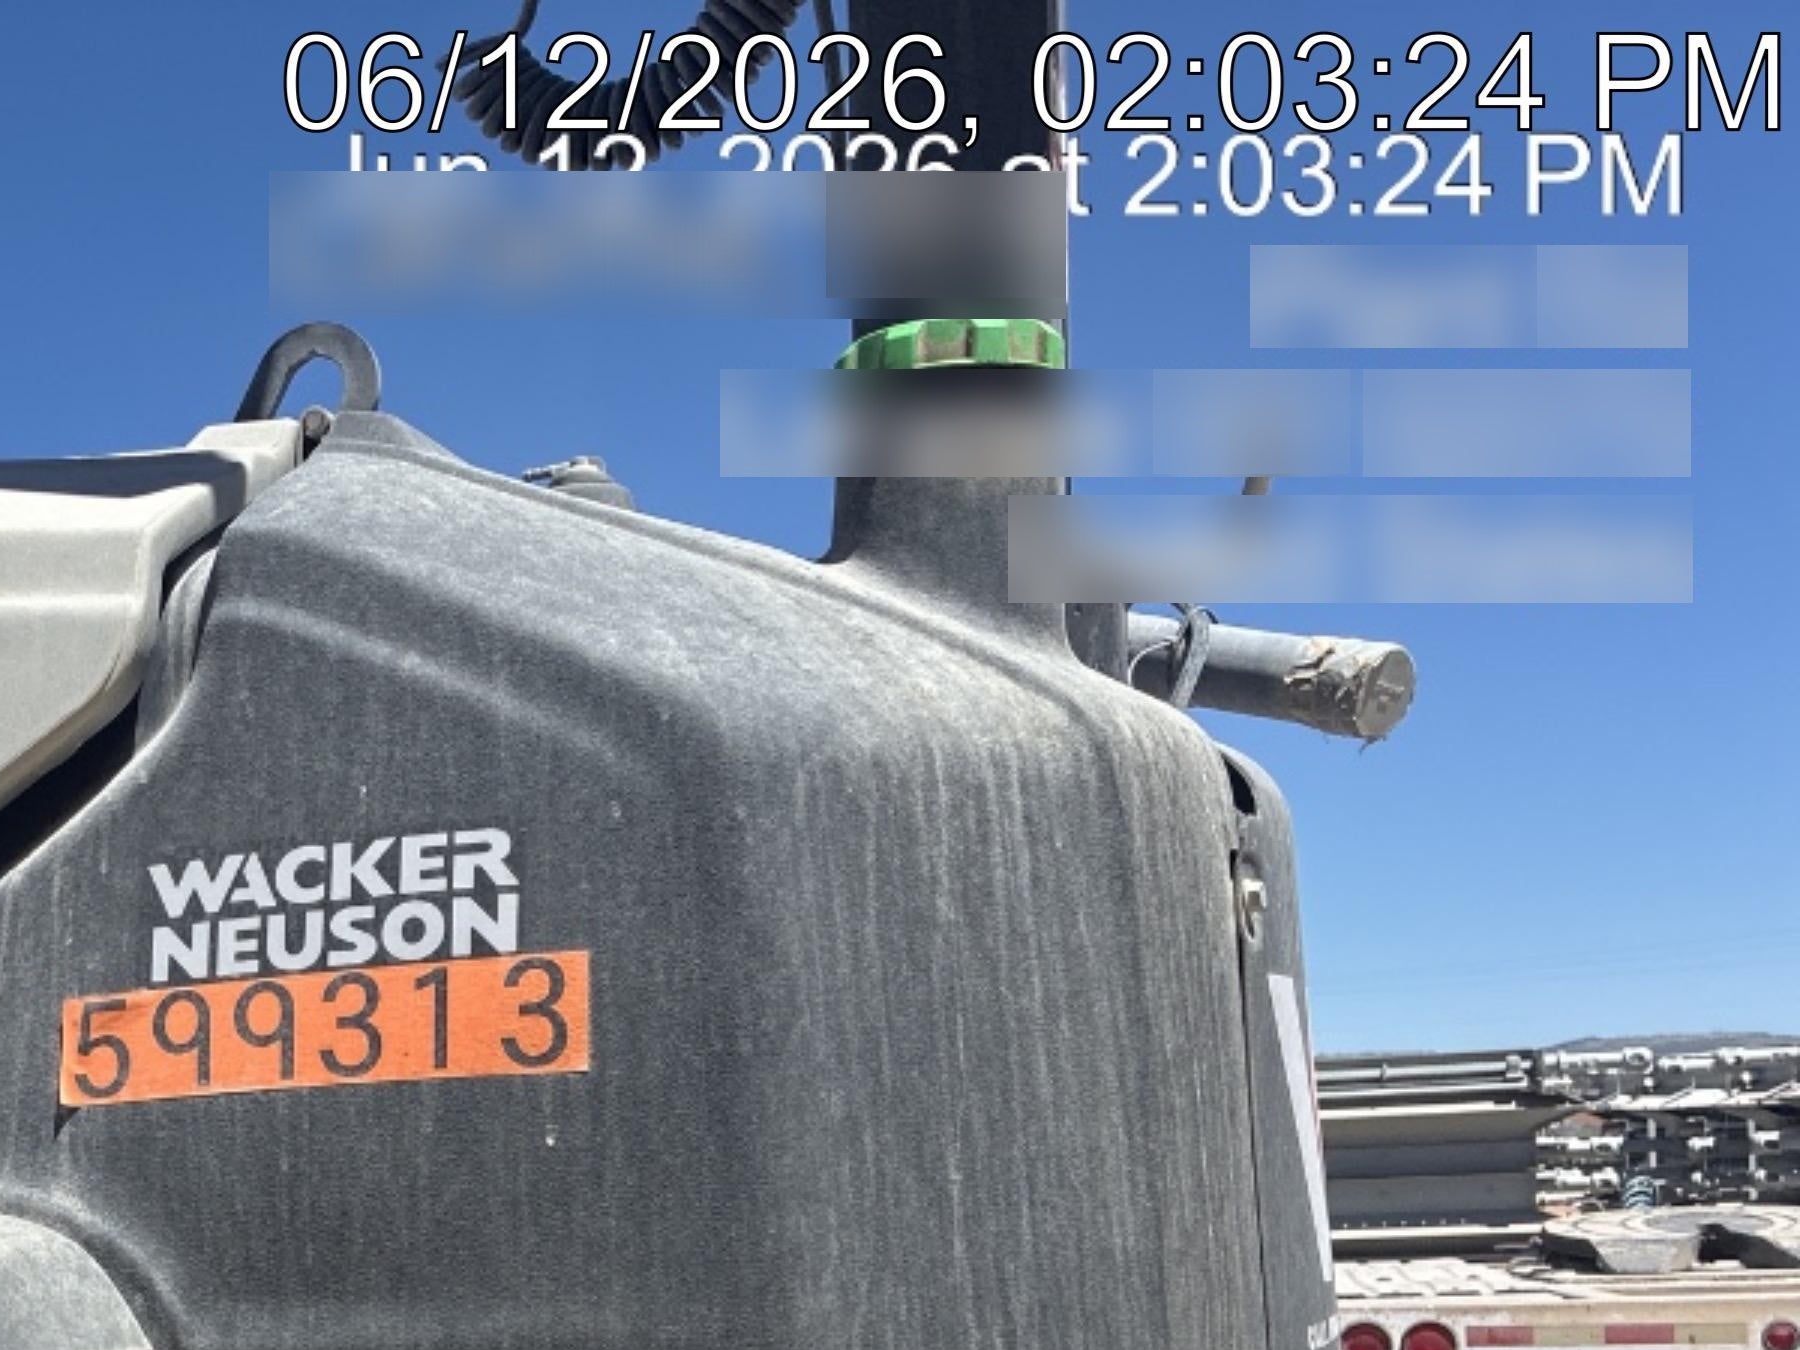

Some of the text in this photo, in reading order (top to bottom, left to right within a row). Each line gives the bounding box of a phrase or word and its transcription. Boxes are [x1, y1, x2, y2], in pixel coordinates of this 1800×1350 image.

[146, 827, 520, 920] WACKER
[150, 892, 520, 984] NEUSON
[73, 956, 569, 1100] 599313
